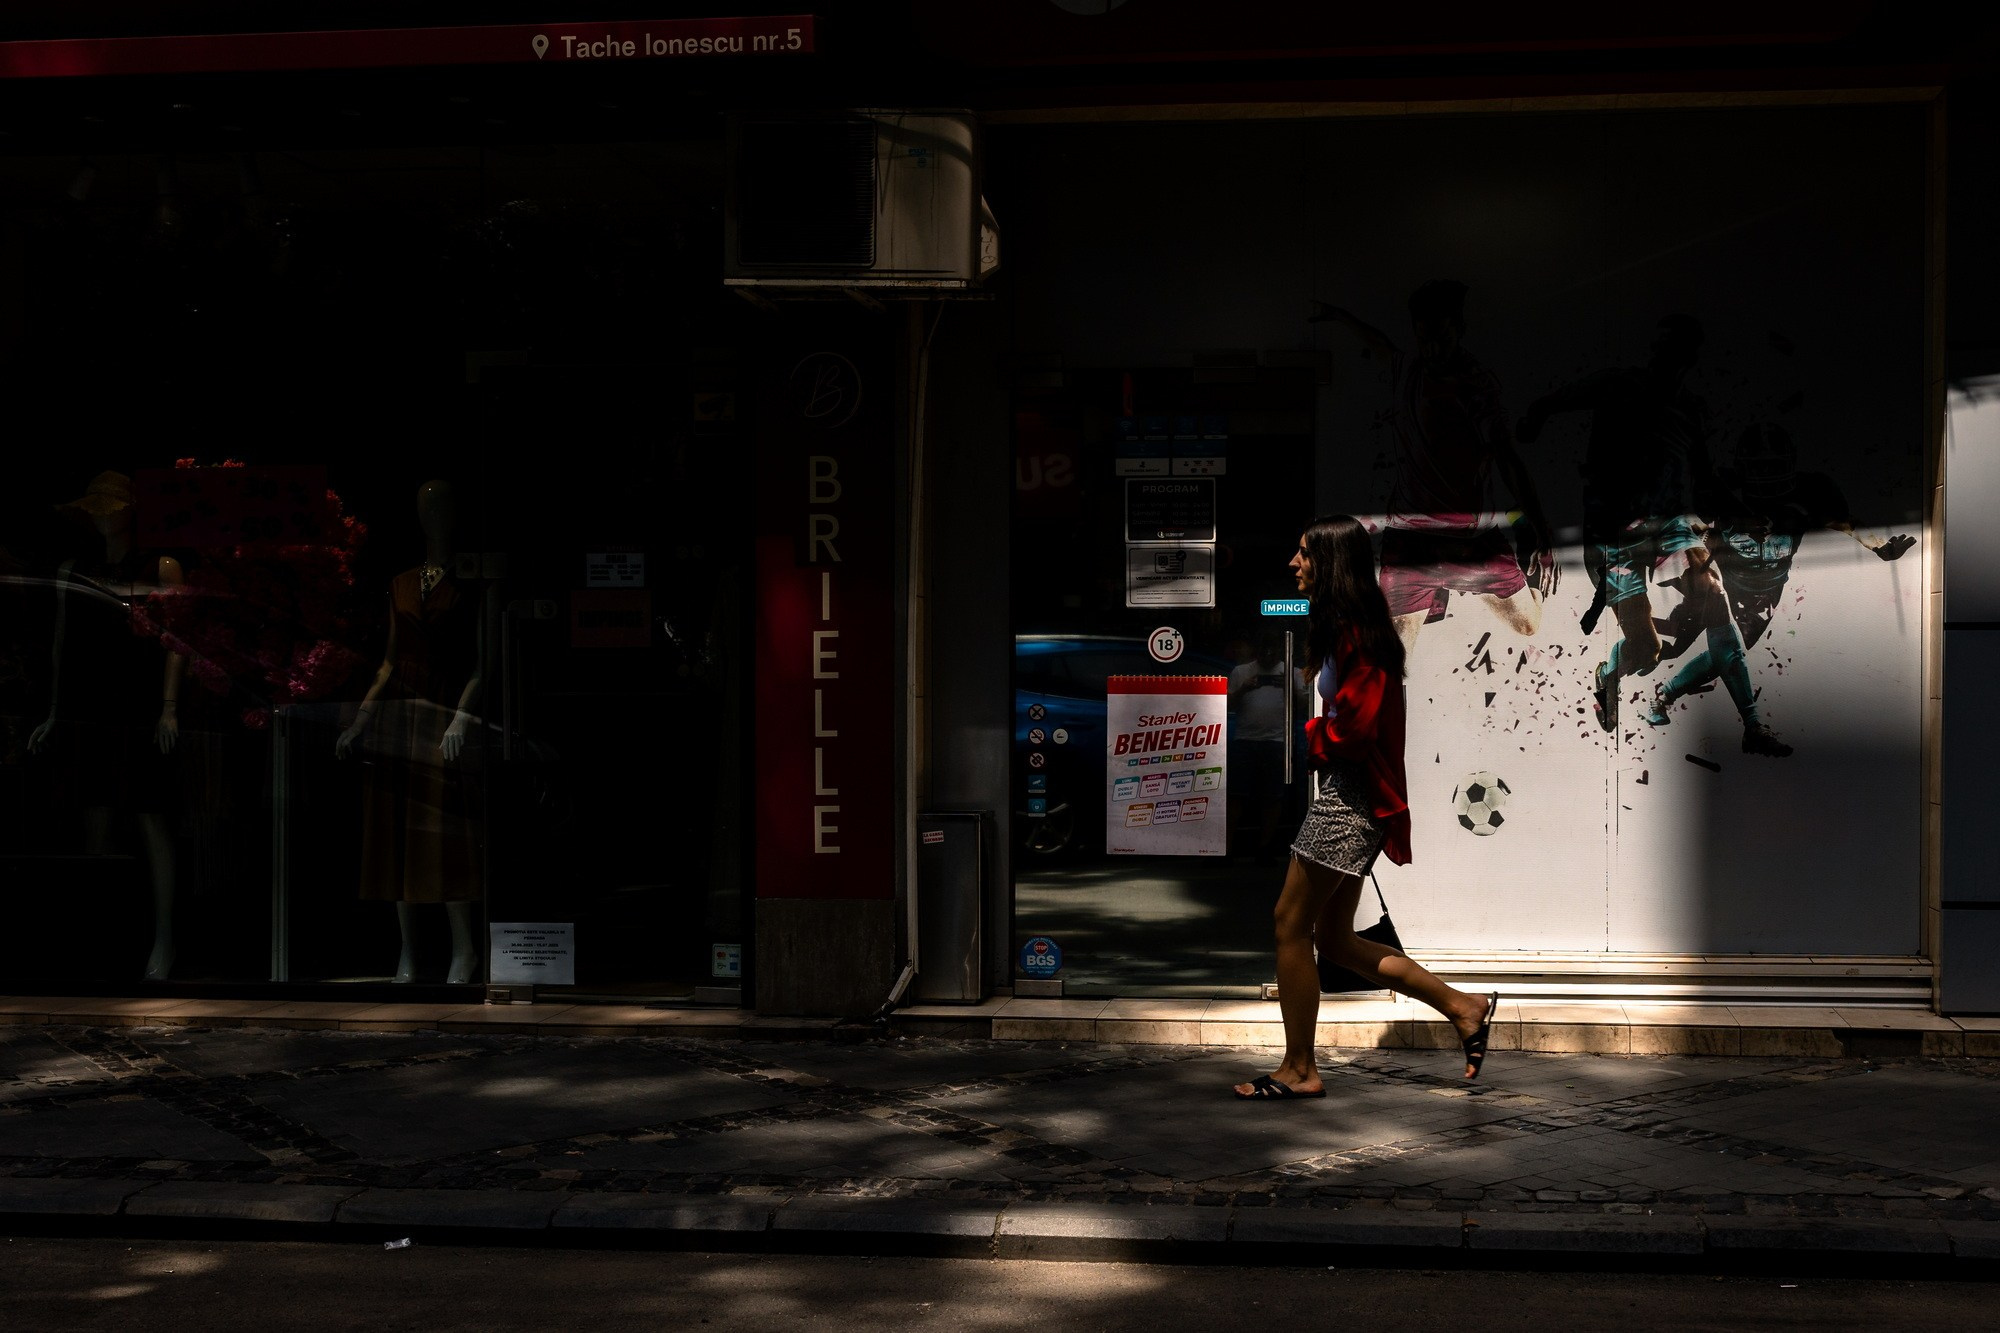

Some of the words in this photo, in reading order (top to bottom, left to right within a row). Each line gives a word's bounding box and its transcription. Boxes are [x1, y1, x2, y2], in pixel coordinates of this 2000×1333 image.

[561, 34, 636, 58] Tache
[645, 33, 744, 56] Ionescu
[752, 28, 802, 51] nr.5
[1142, 484, 1199, 494] PROGRAM
[1263, 601, 1307, 613] ÎMPINGE
[808, 454, 843, 854] BRIELLE
[1137, 711, 1197, 728] Stanley
[1113, 723, 1222, 756] BENEFICII
[1026, 954, 1056, 966] BGS
